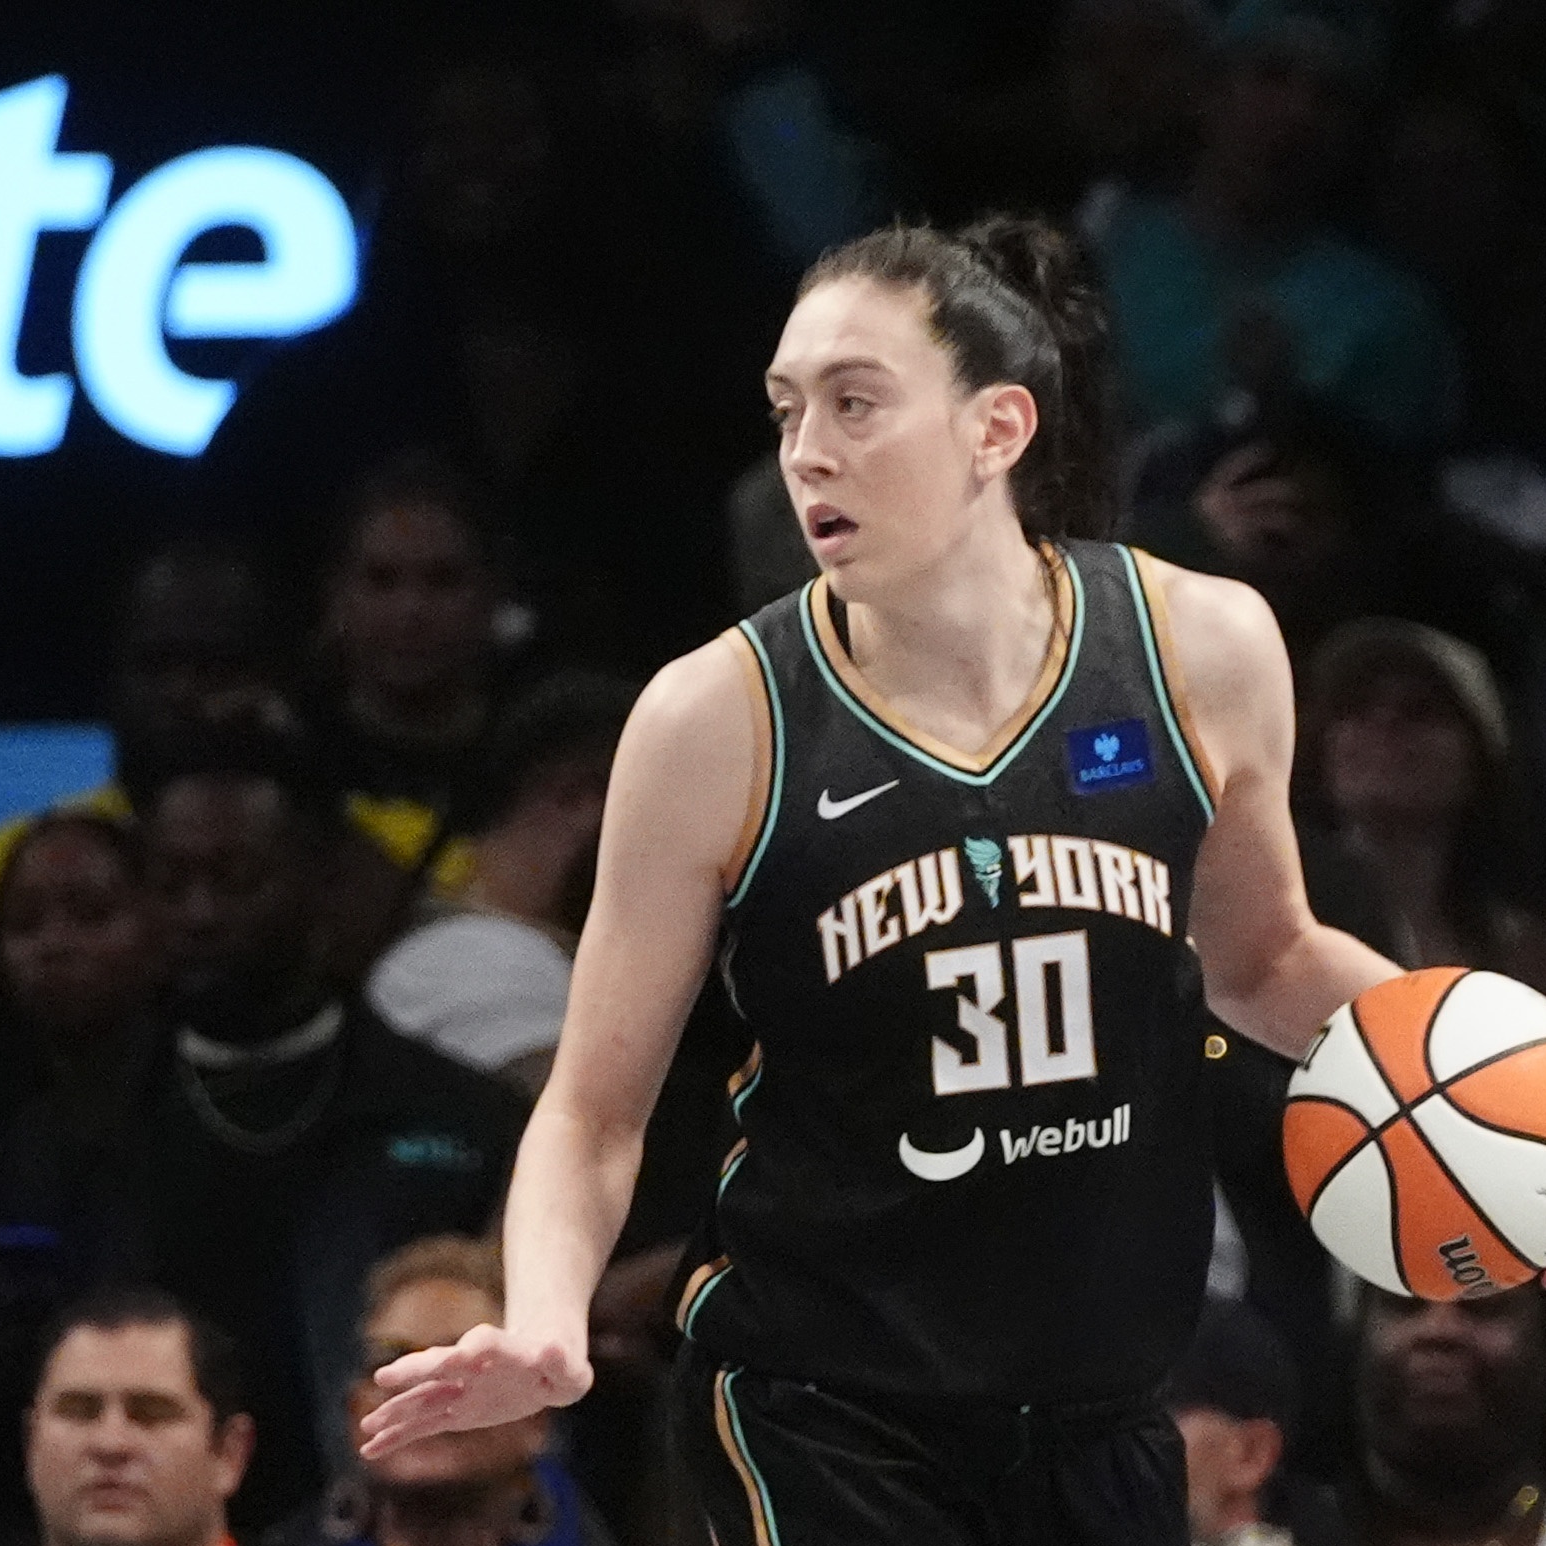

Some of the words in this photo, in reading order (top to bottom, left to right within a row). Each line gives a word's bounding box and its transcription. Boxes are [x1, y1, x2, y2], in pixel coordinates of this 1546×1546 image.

[816, 846, 964, 985] NEW
[1007, 834, 1173, 938] YORK
[924, 929, 1097, 1096] 30
[999, 1103, 1132, 1166] Webull
